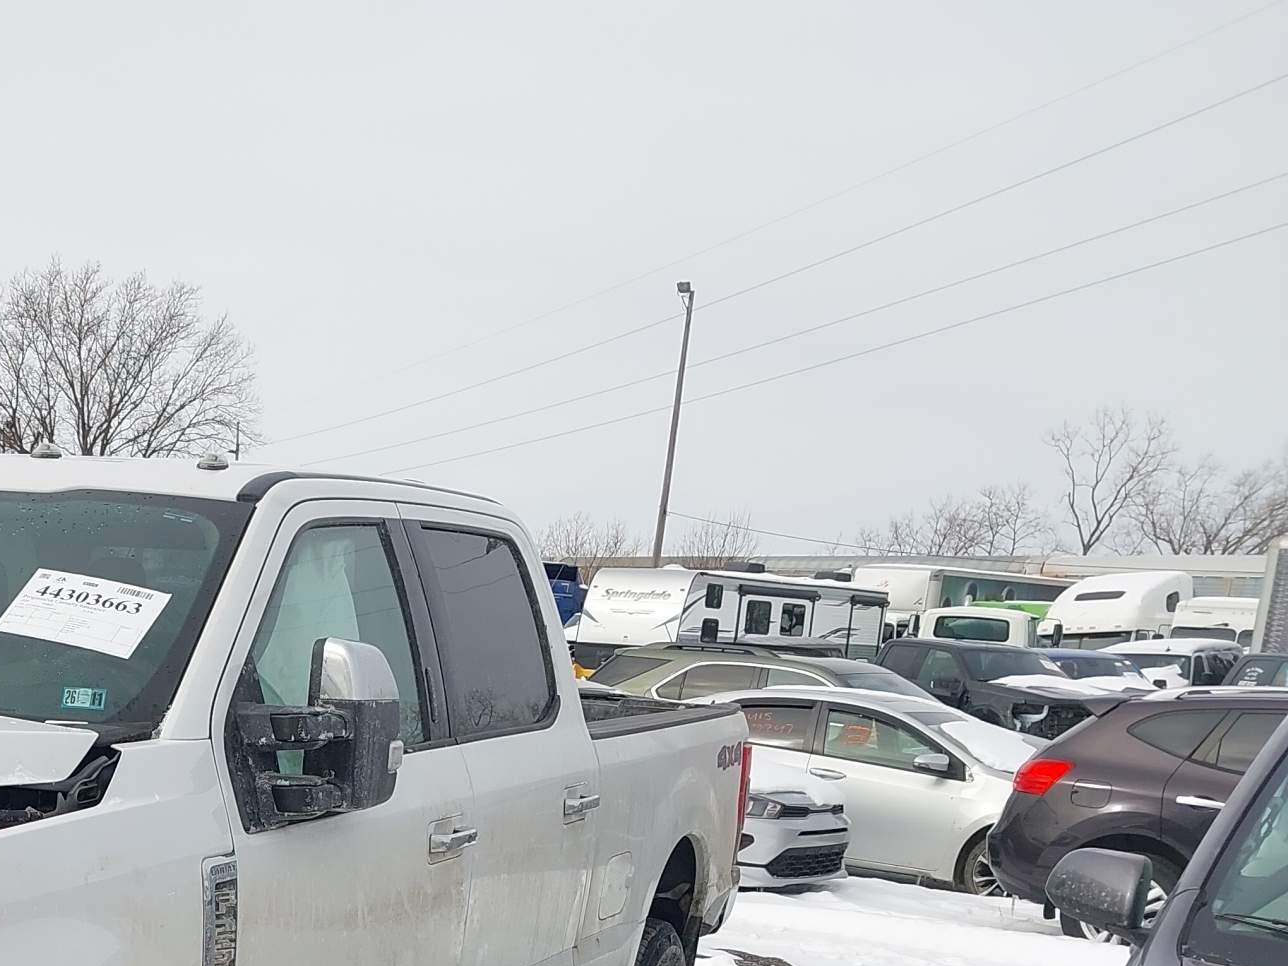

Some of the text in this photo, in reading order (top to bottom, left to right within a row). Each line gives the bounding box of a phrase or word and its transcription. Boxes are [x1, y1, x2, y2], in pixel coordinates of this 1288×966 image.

[36, 585, 143, 615] 44303663
[601, 588, 672, 602] Springdale
[64, 690, 77, 704] 26
[91, 691, 103, 706] 11
